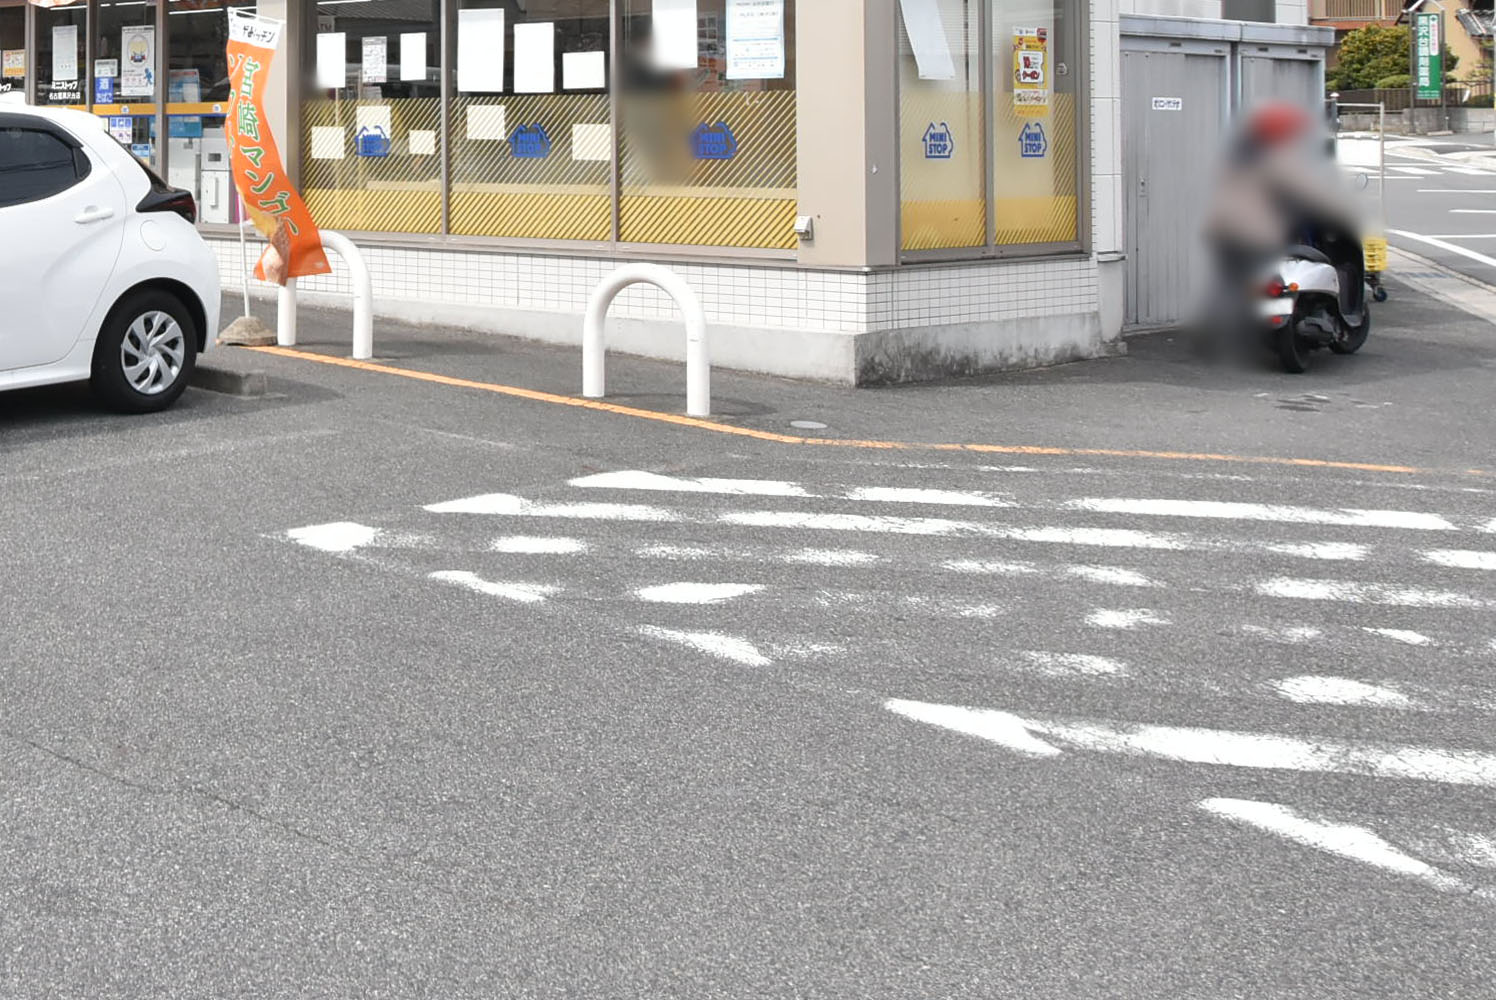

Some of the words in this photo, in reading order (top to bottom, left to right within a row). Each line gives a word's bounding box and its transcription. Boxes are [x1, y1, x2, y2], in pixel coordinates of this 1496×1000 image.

[928, 131, 947, 143] MINI
[1023, 131, 1042, 142] MINI
[928, 143, 948, 154] STOP
[1023, 142, 1043, 153] STOP
